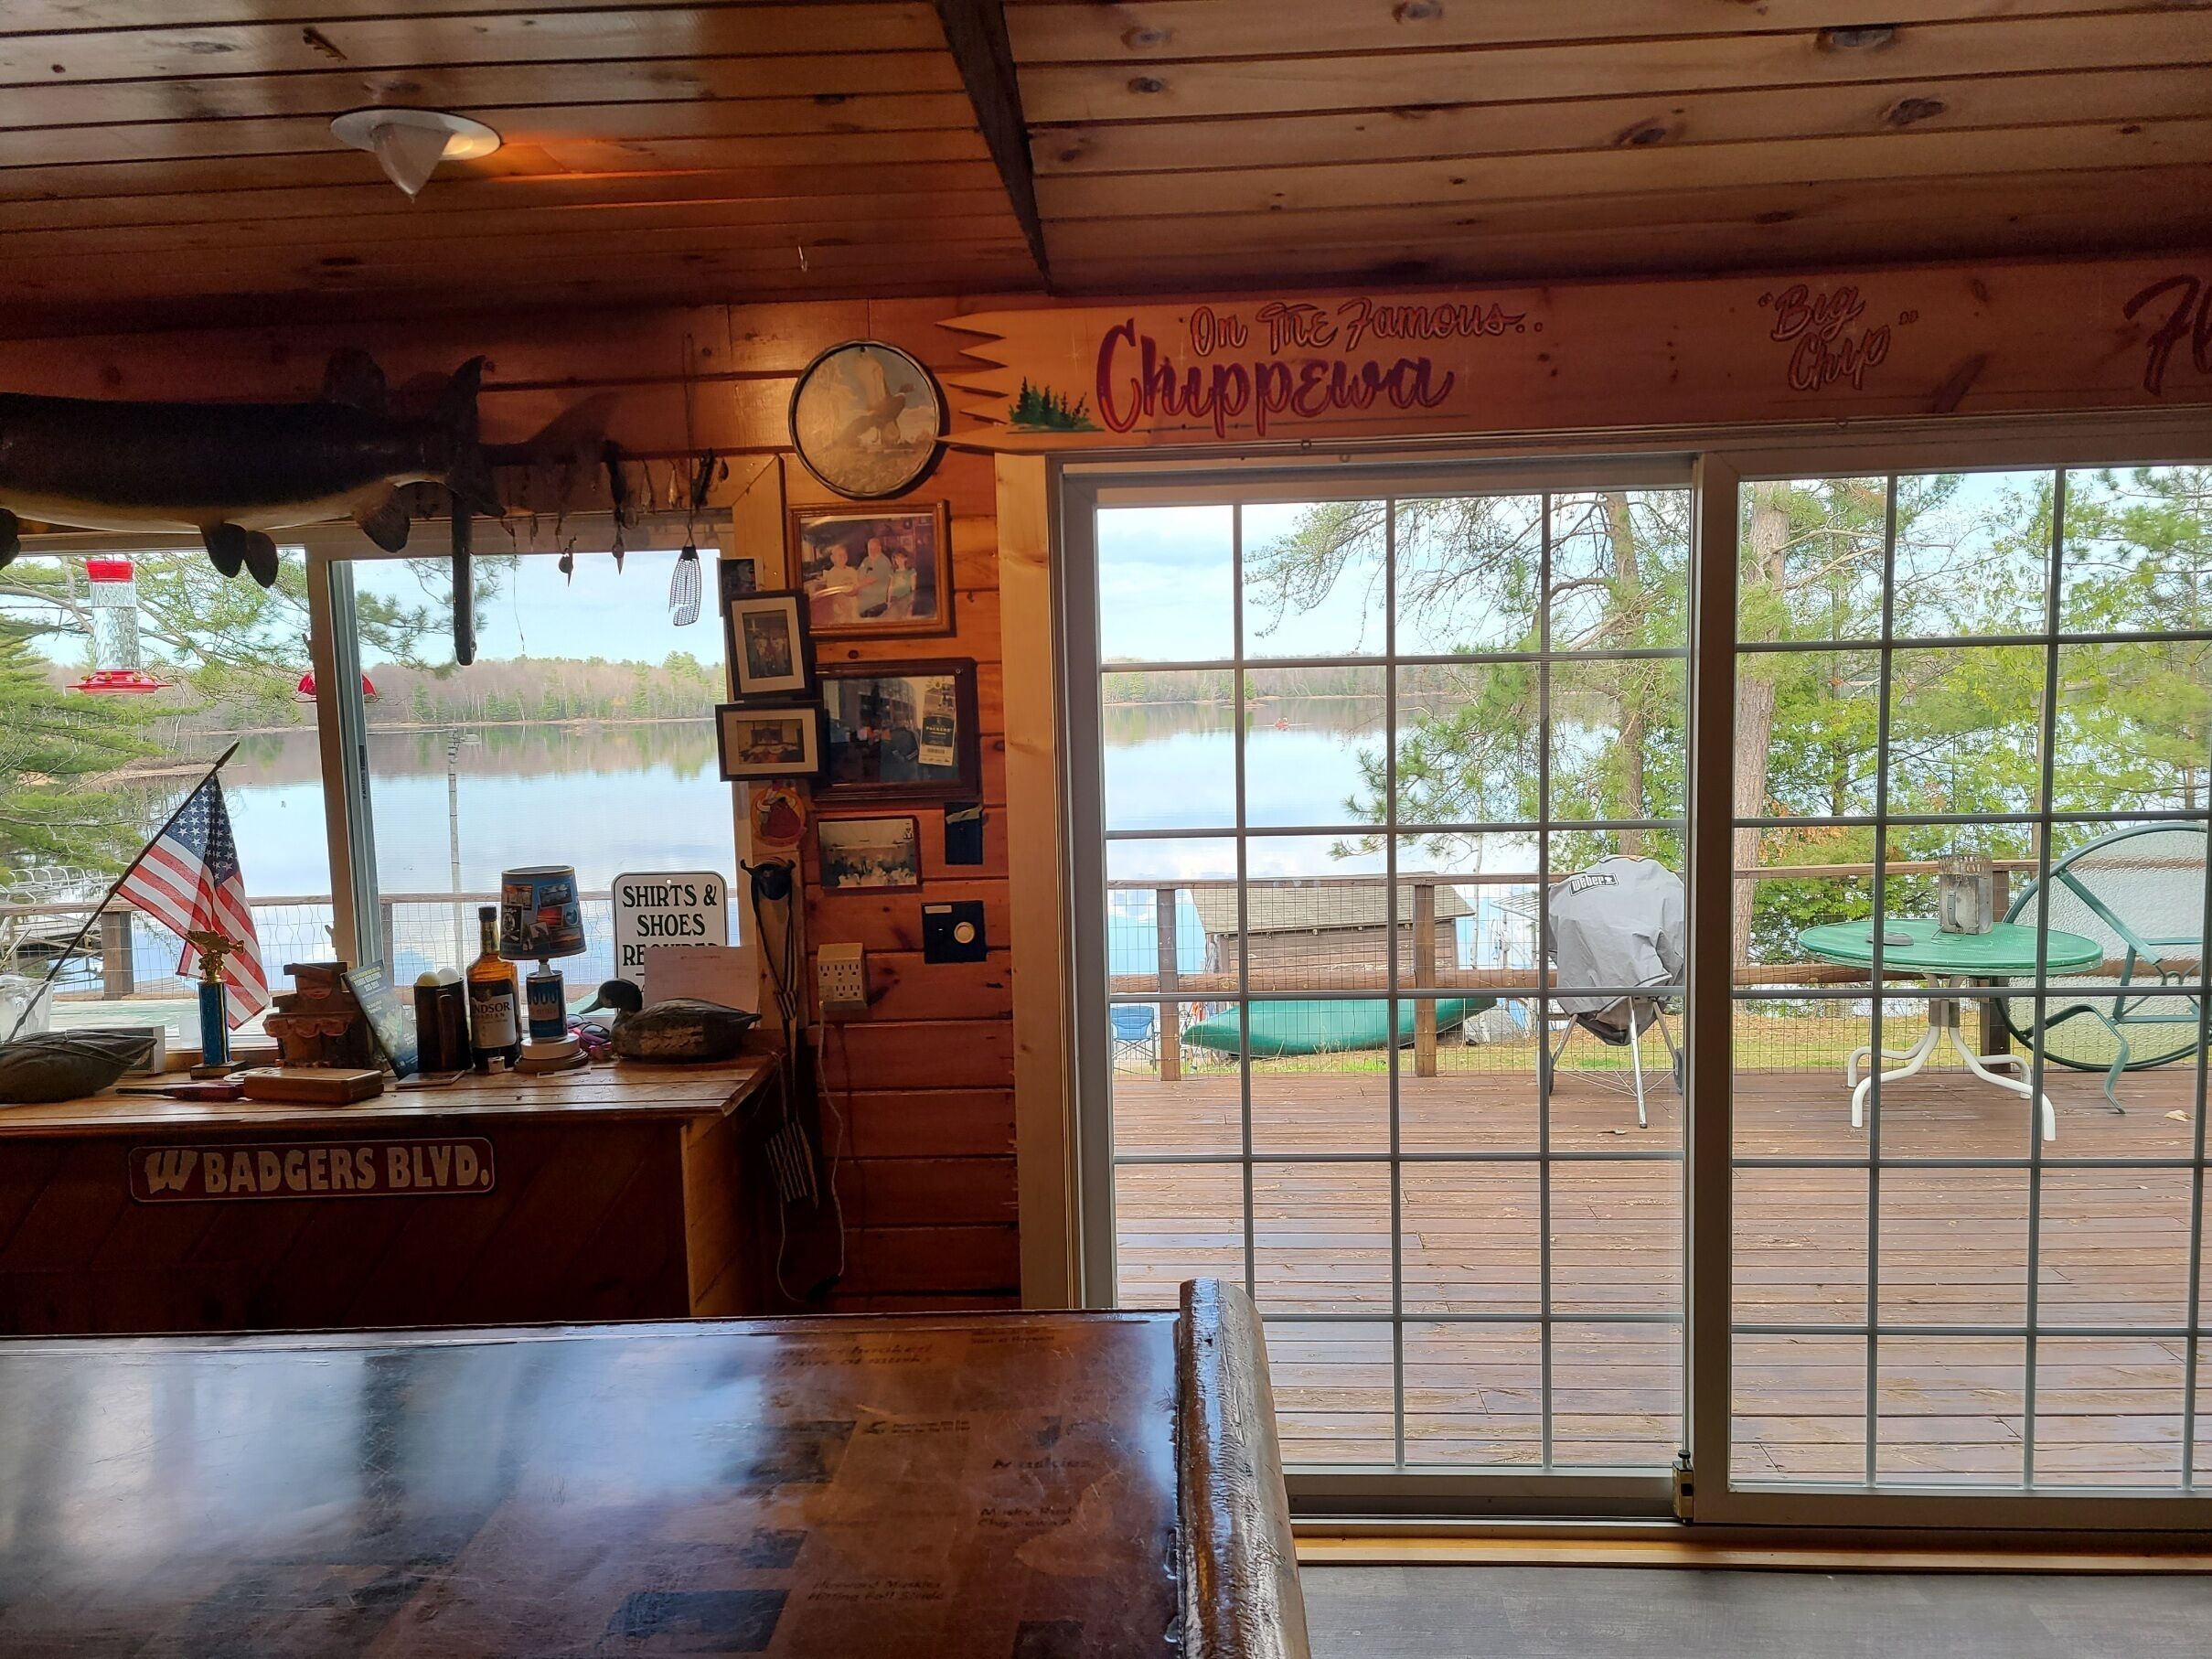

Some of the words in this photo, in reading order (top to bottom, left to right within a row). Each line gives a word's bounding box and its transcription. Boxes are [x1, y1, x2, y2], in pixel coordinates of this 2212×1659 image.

[1189, 305, 1247, 358] On
[1096, 316, 1455, 439] Chippewa
[622, 883, 697, 908] SHIRTS
[703, 883, 718, 906] &
[636, 913, 706, 937] SHOES
[472, 1001, 512, 1014] NDSOR
[203, 1148, 376, 1193] BADGERS
[387, 1145, 491, 1188] BLVD.
